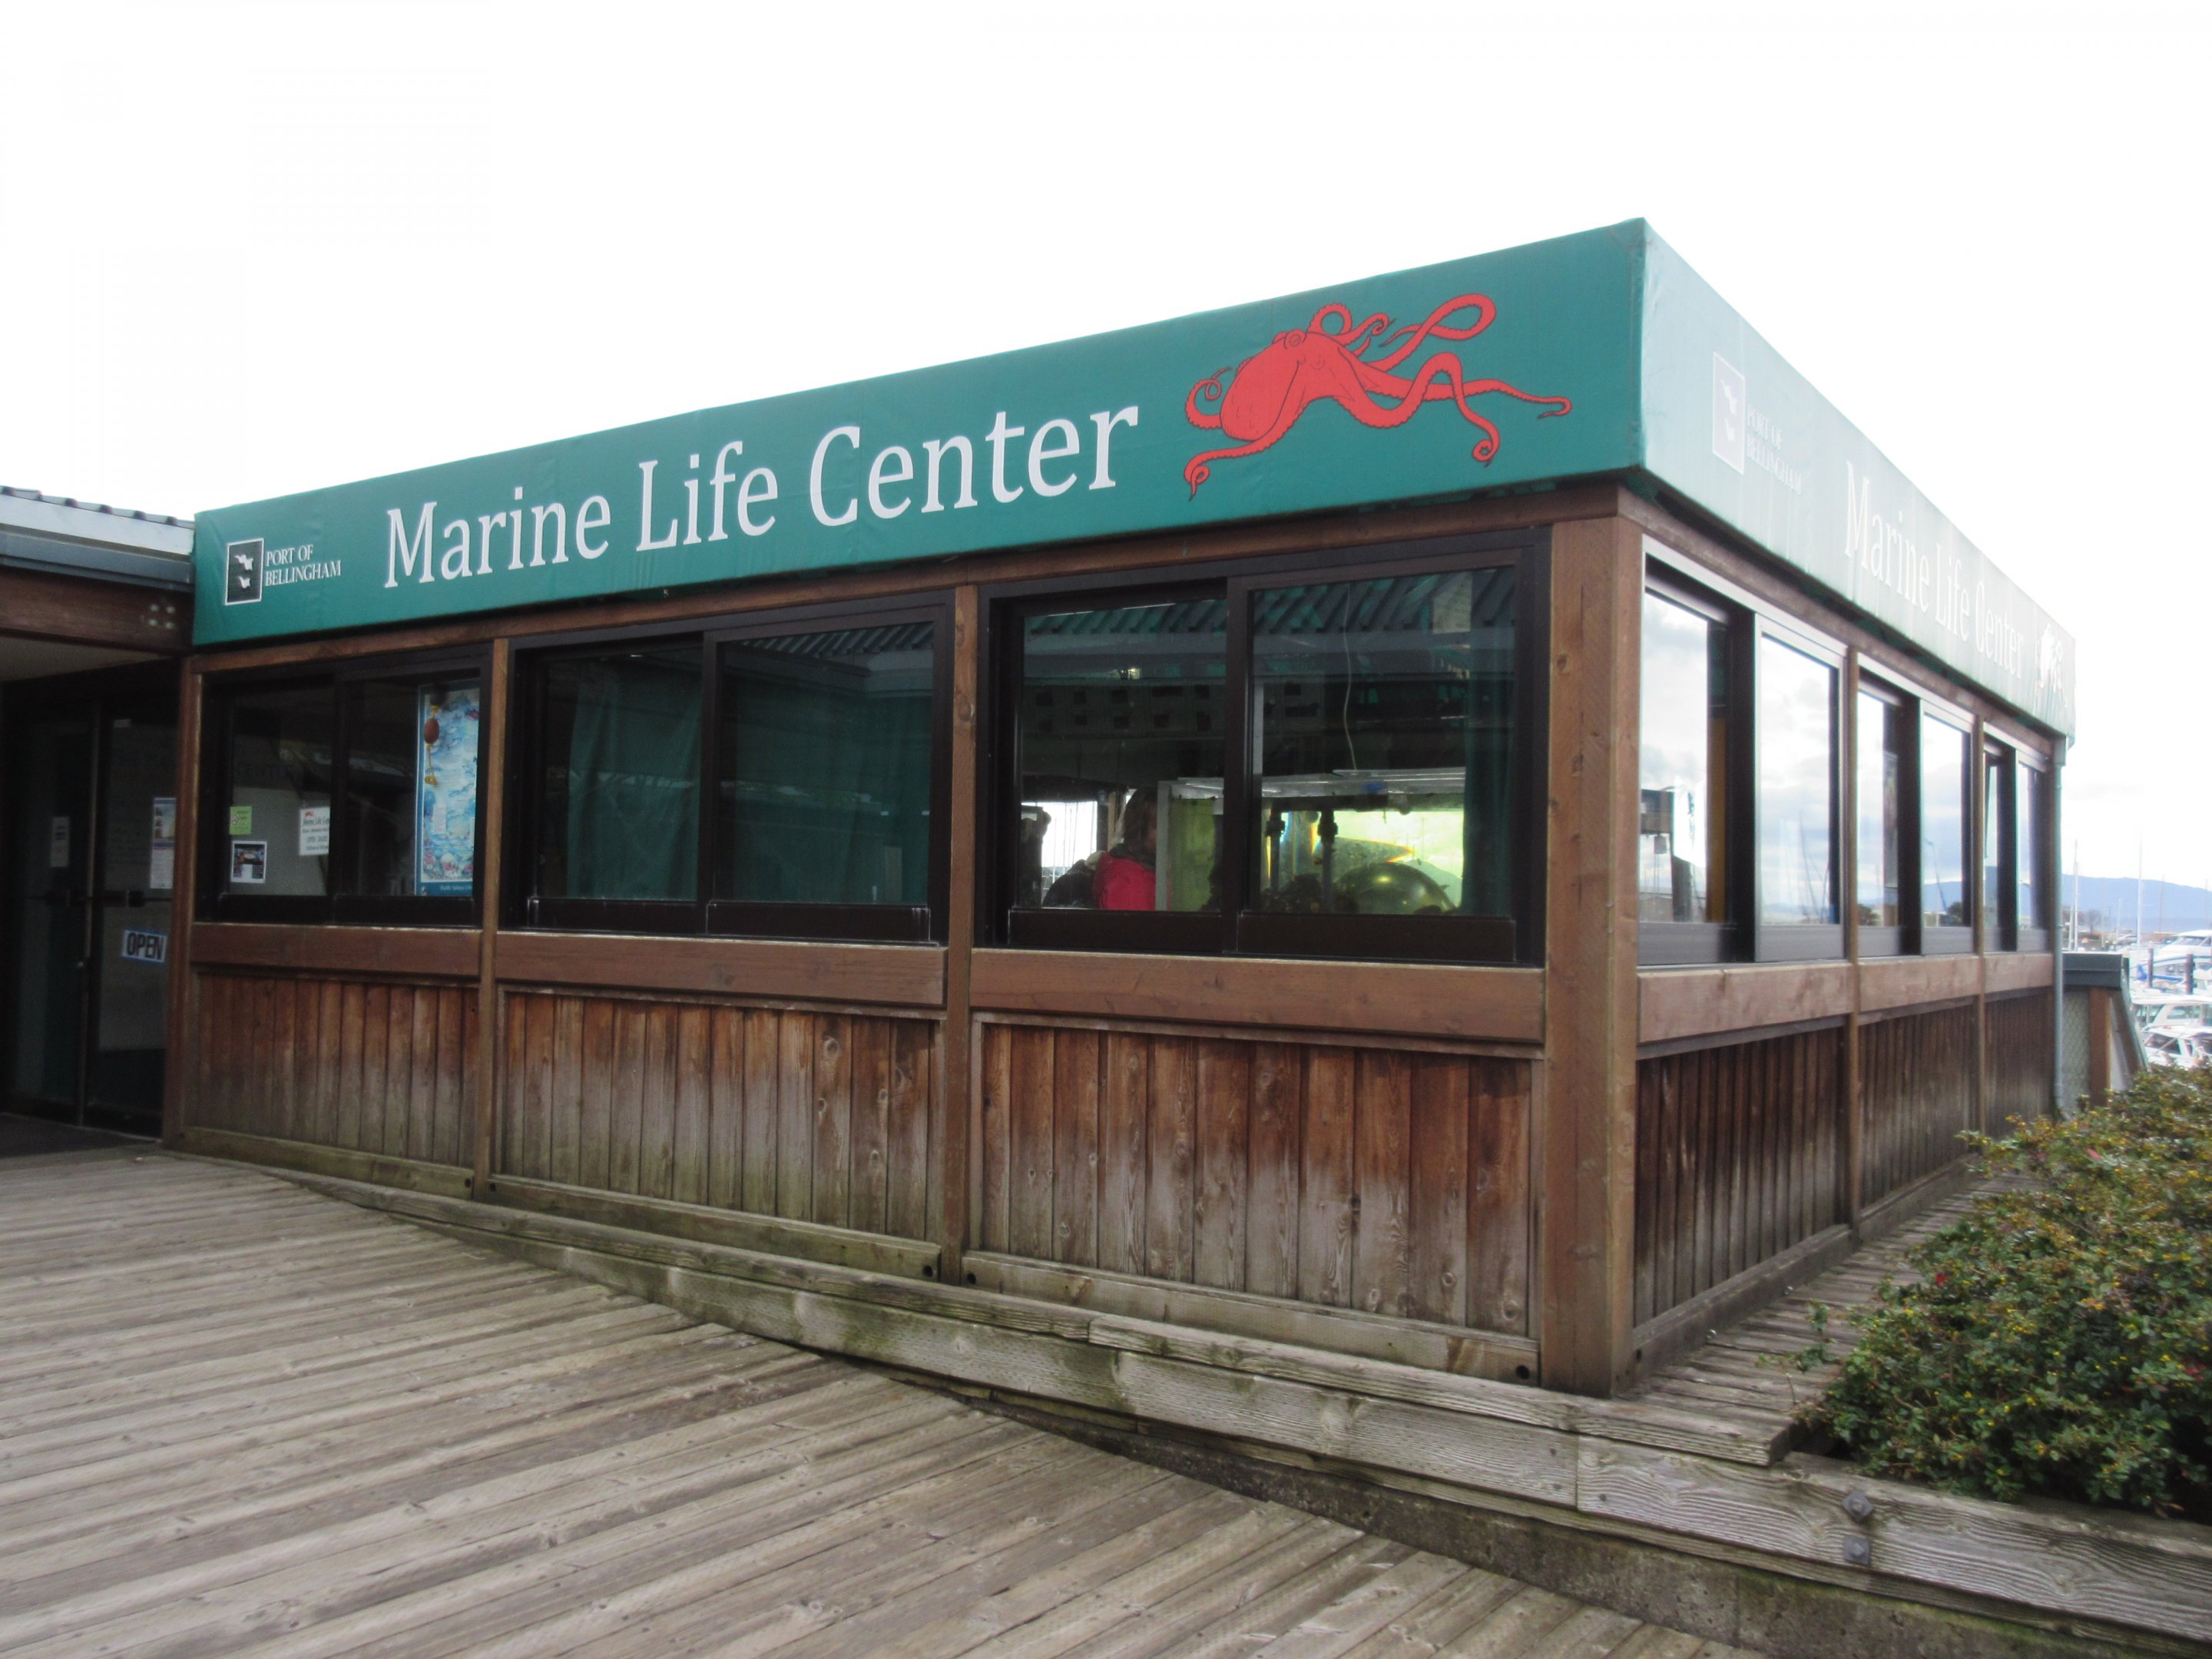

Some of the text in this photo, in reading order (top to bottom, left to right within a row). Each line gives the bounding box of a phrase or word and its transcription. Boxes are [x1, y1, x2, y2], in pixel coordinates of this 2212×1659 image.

[384, 404, 1139, 588] Marine Life Center
[265, 544, 314, 567] PORT OF
[1844, 460, 2024, 680] Marine Life Center
[265, 559, 343, 587] BELLINGHAM
[126, 931, 164, 962] OPEN
